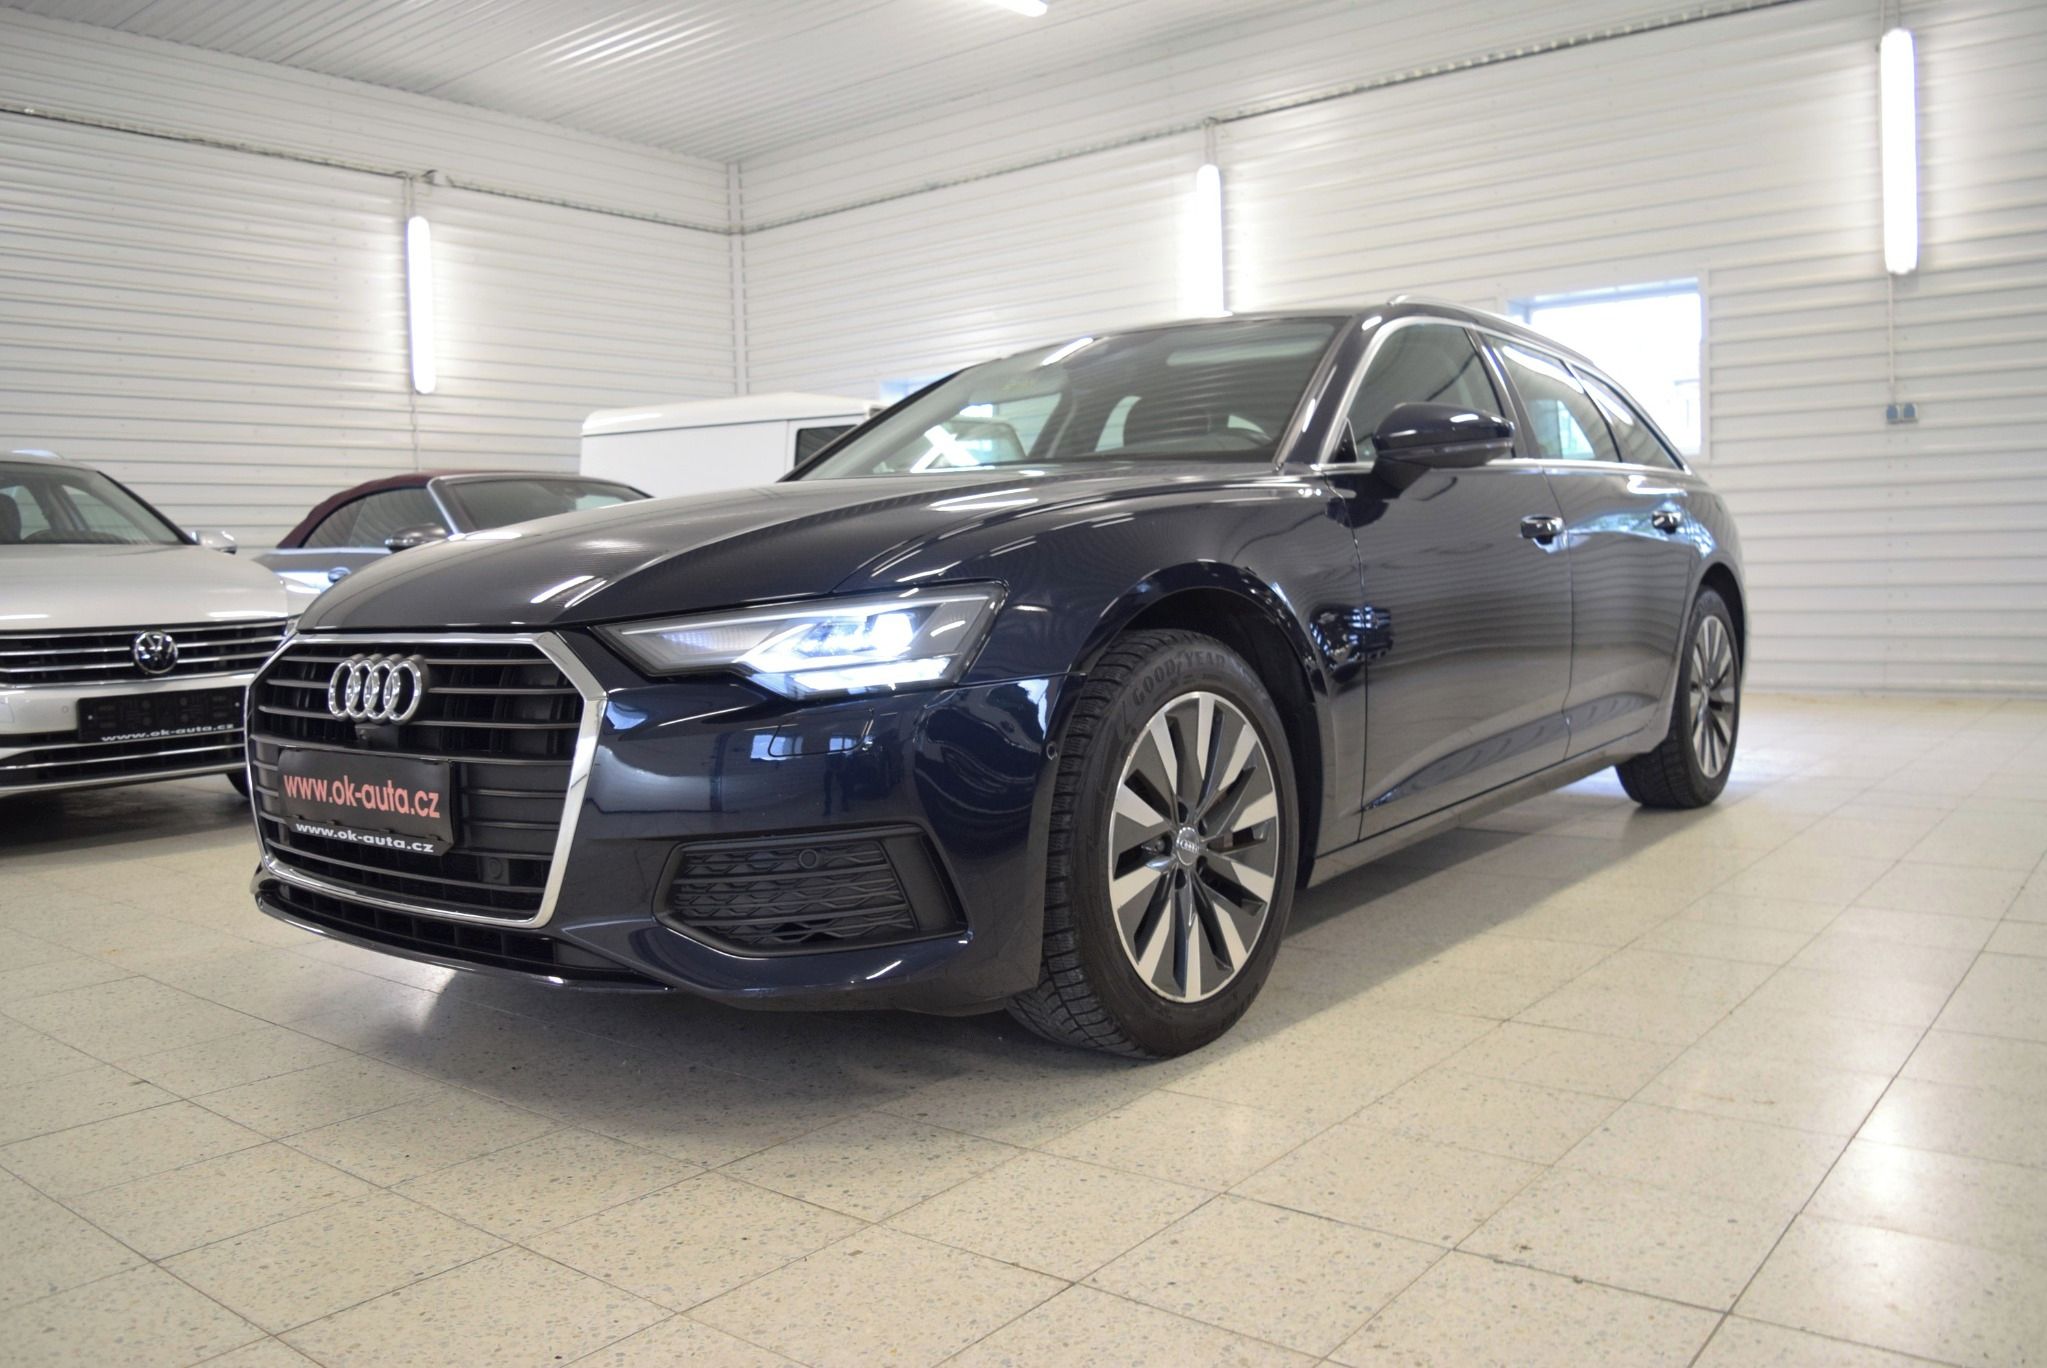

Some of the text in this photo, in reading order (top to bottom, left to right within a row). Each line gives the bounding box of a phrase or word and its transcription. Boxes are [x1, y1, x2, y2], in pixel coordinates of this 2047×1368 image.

[102, 723, 234, 742] www.ok-auta.cz
[283, 774, 440, 818] www.ok-auta.cz
[296, 823, 434, 853] www.ok-auta.cz
